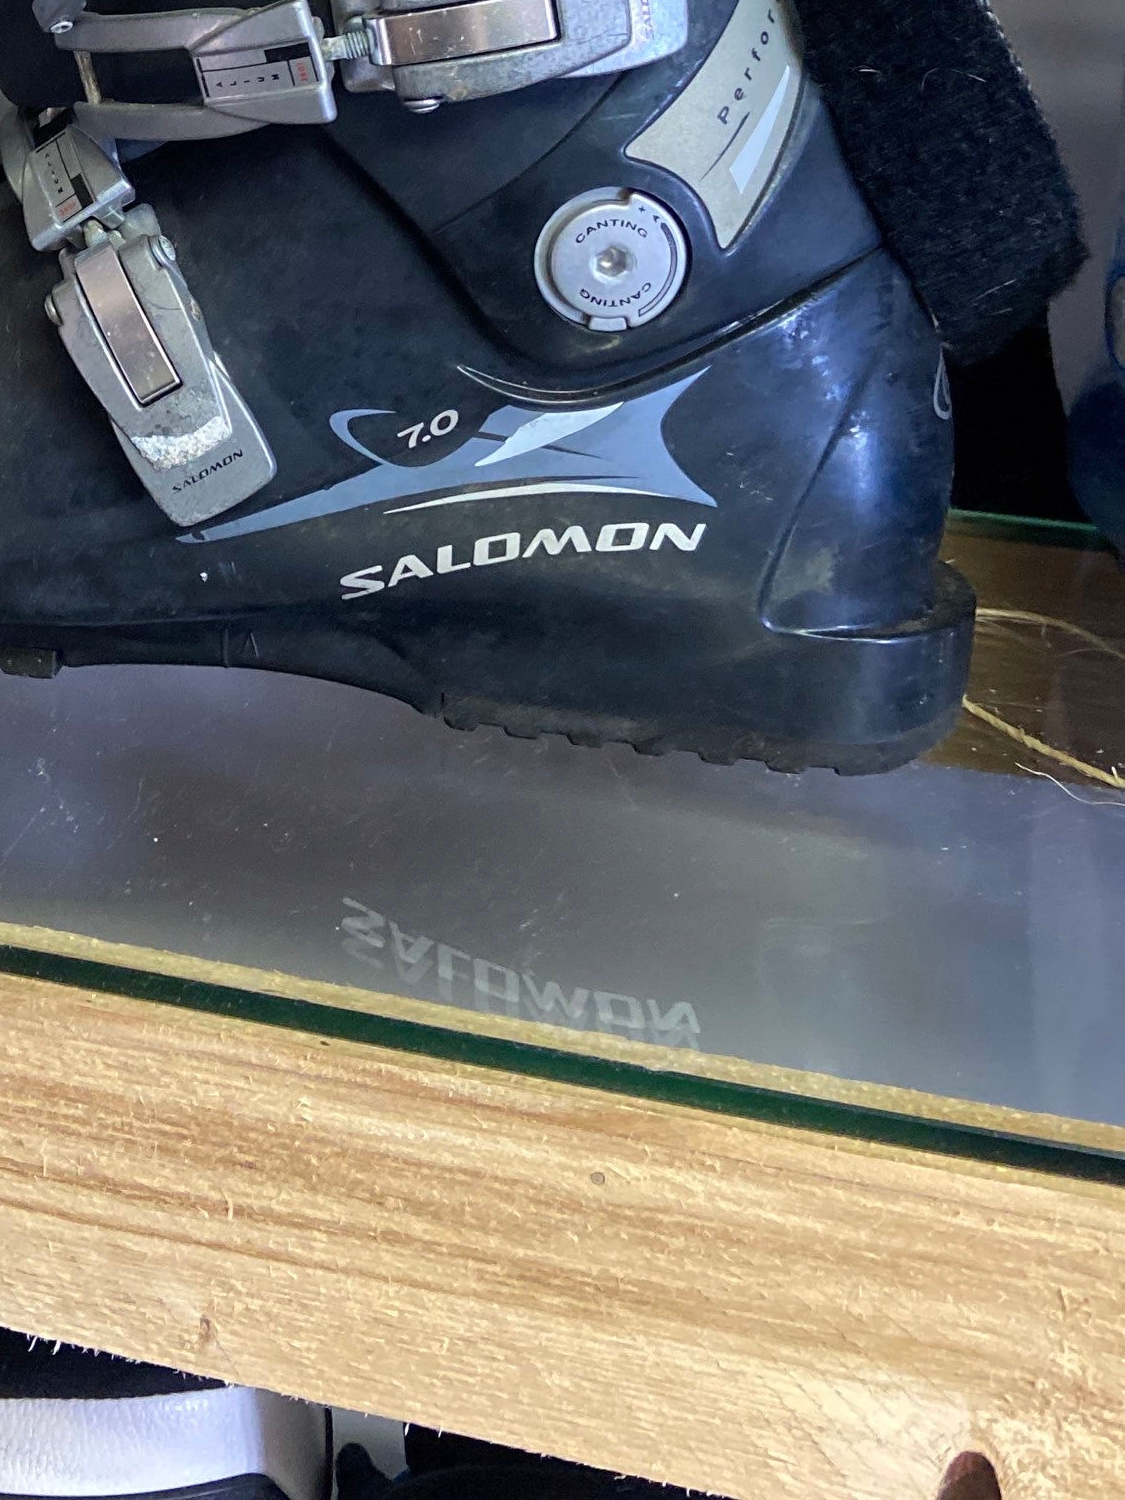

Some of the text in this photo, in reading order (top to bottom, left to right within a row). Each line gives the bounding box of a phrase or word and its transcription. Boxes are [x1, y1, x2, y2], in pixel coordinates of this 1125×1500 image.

[574, 217, 649, 245] CANTING
[579, 280, 652, 308] CANTING
[396, 408, 460, 450] 7.0
[171, 448, 244, 495] SALOMON
[340, 521, 708, 601] SALOMON
